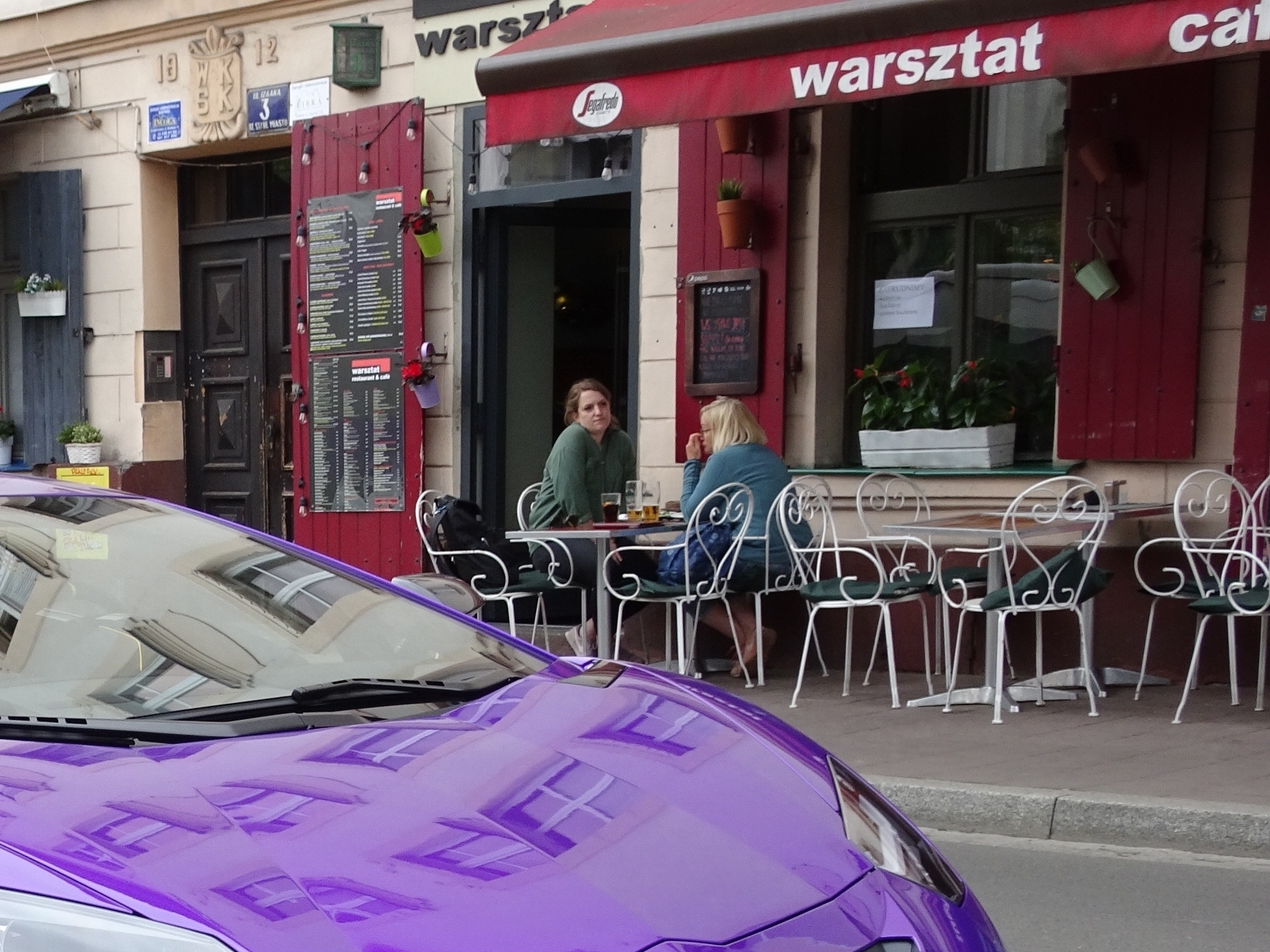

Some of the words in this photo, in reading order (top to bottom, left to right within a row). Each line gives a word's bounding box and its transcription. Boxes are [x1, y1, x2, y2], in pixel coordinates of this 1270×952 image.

[254, 36, 279, 66] 12
[790, 22, 1044, 99] warsztat
[260, 88, 282, 98] IZAAKA
[577, 90, 619, 117] Segafredo
[259, 98, 270, 121] 3
[351, 366, 380, 375] warsztat
